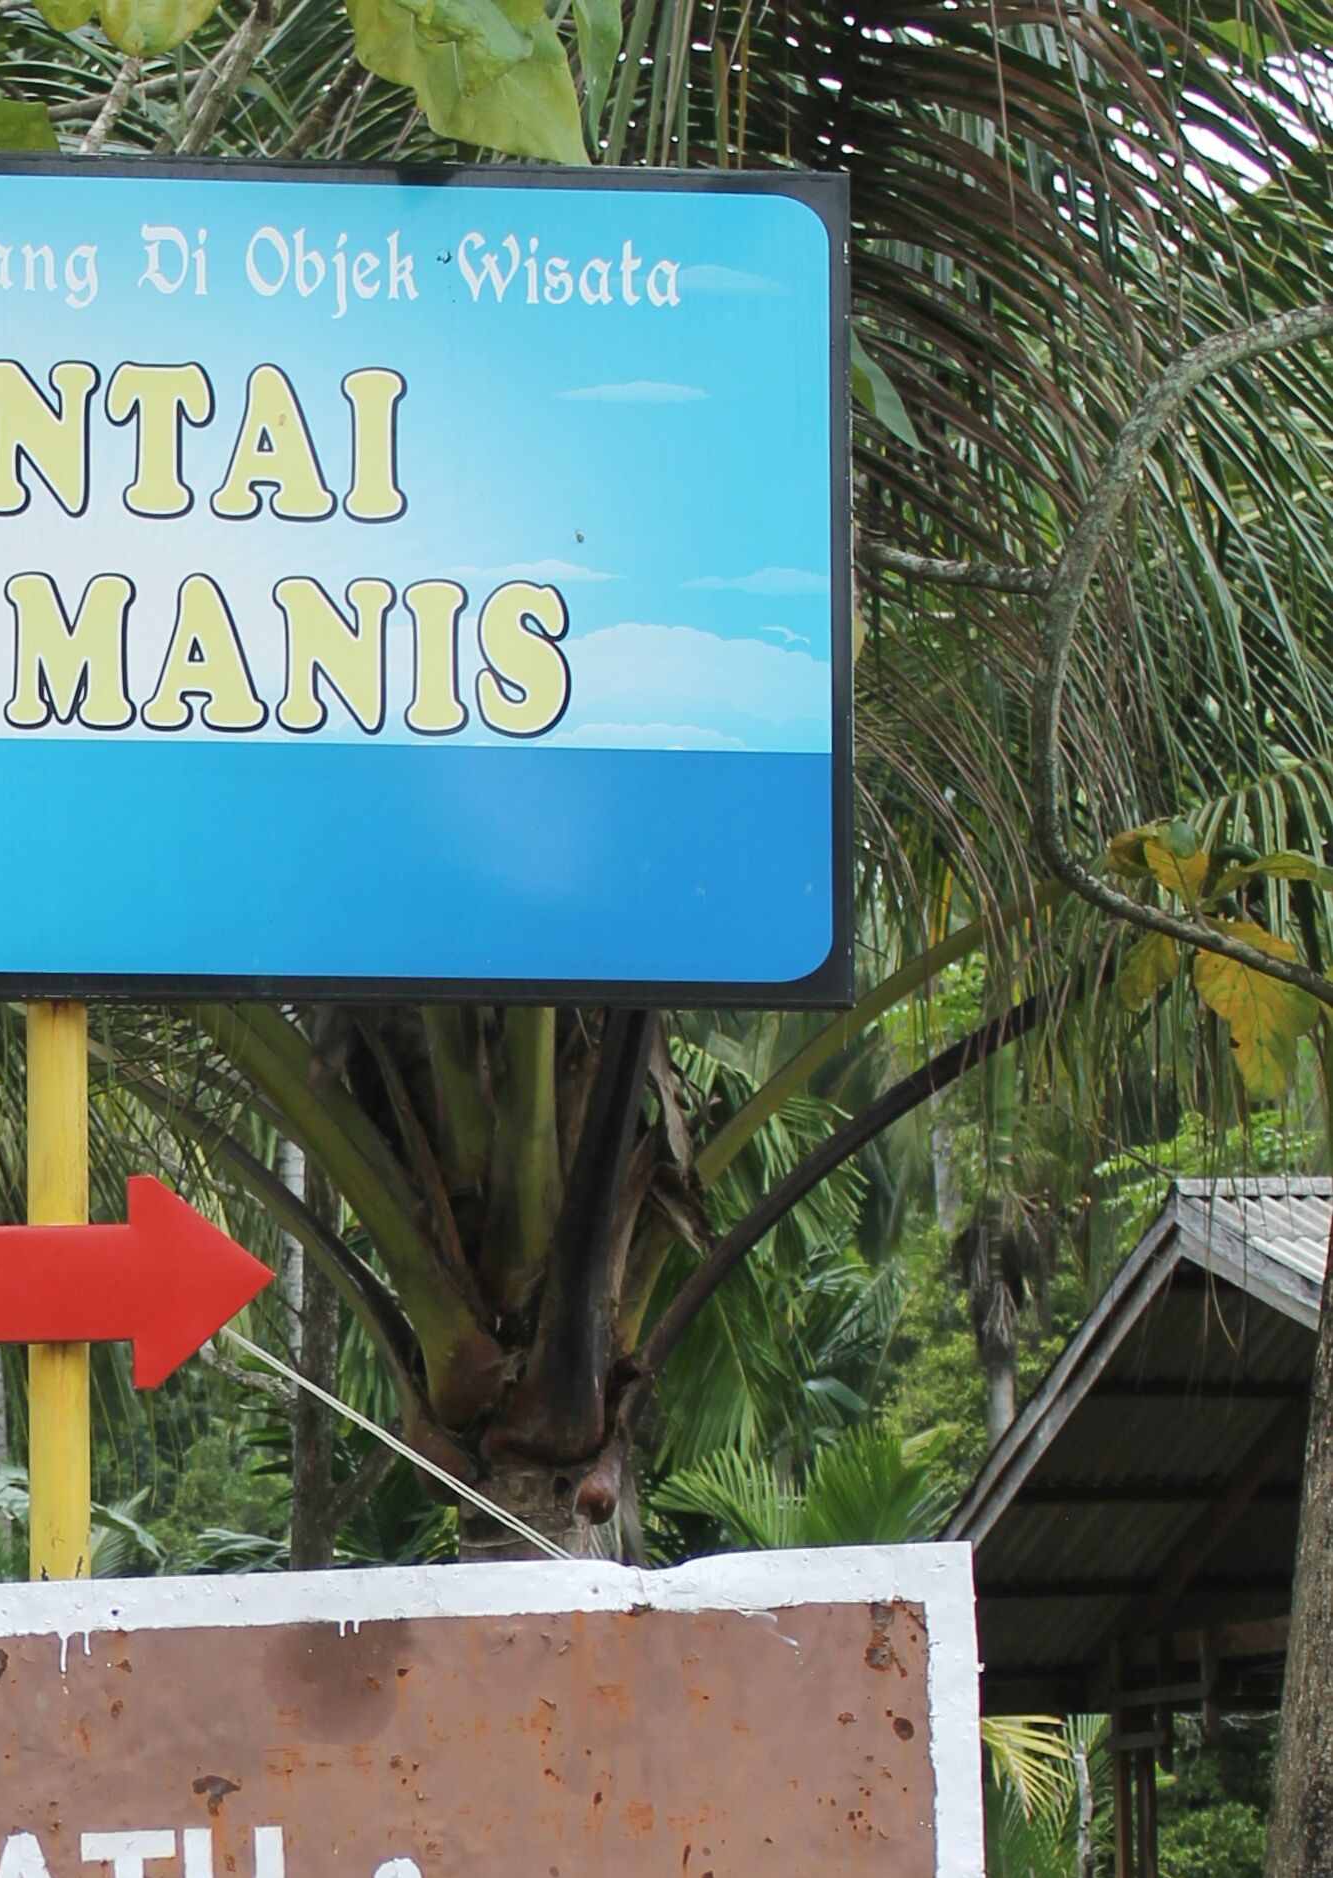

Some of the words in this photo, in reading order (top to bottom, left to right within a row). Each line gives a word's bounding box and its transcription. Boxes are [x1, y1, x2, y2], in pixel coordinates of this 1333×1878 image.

[136, 223, 208, 297] Di
[244, 225, 420, 319] Objek
[457, 231, 683, 308] Wisata
[3, 569, 571, 739] MANIS
